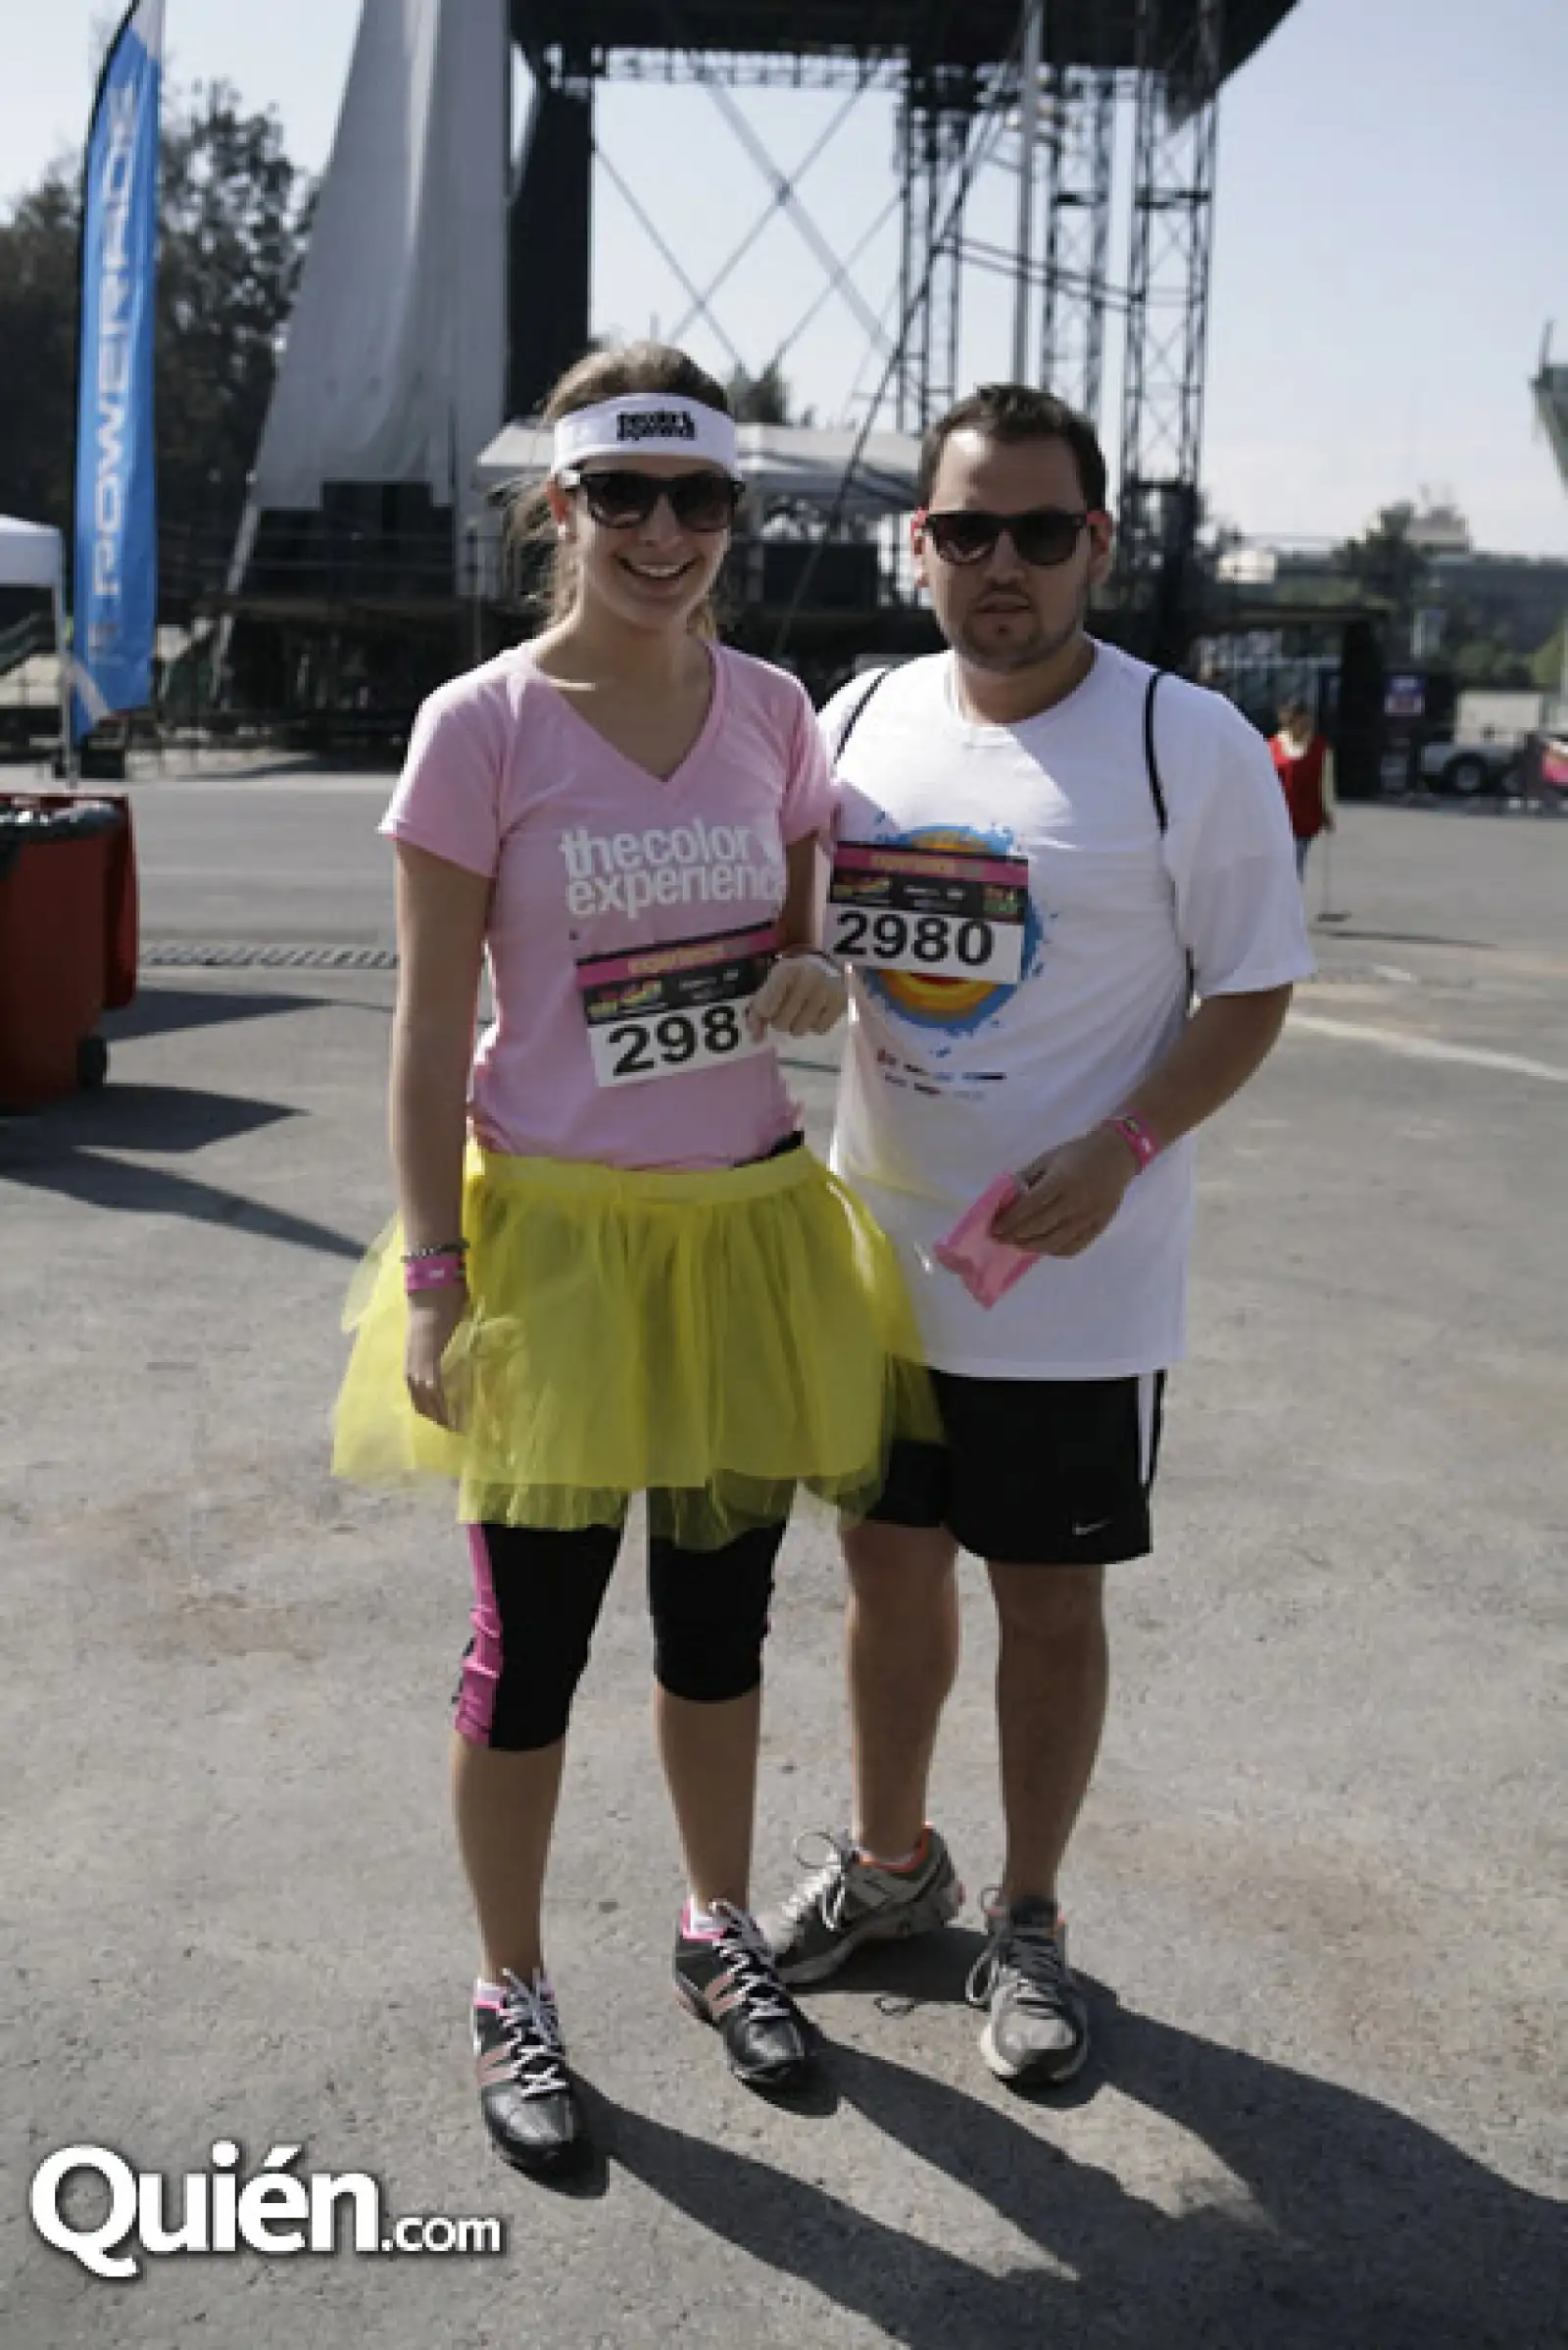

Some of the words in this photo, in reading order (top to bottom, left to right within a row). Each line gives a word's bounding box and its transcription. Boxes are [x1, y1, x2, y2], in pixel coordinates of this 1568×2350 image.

[567, 862, 786, 919] experienc
[834, 910, 994, 966] 2980
[609, 1005, 751, 1075] 298
